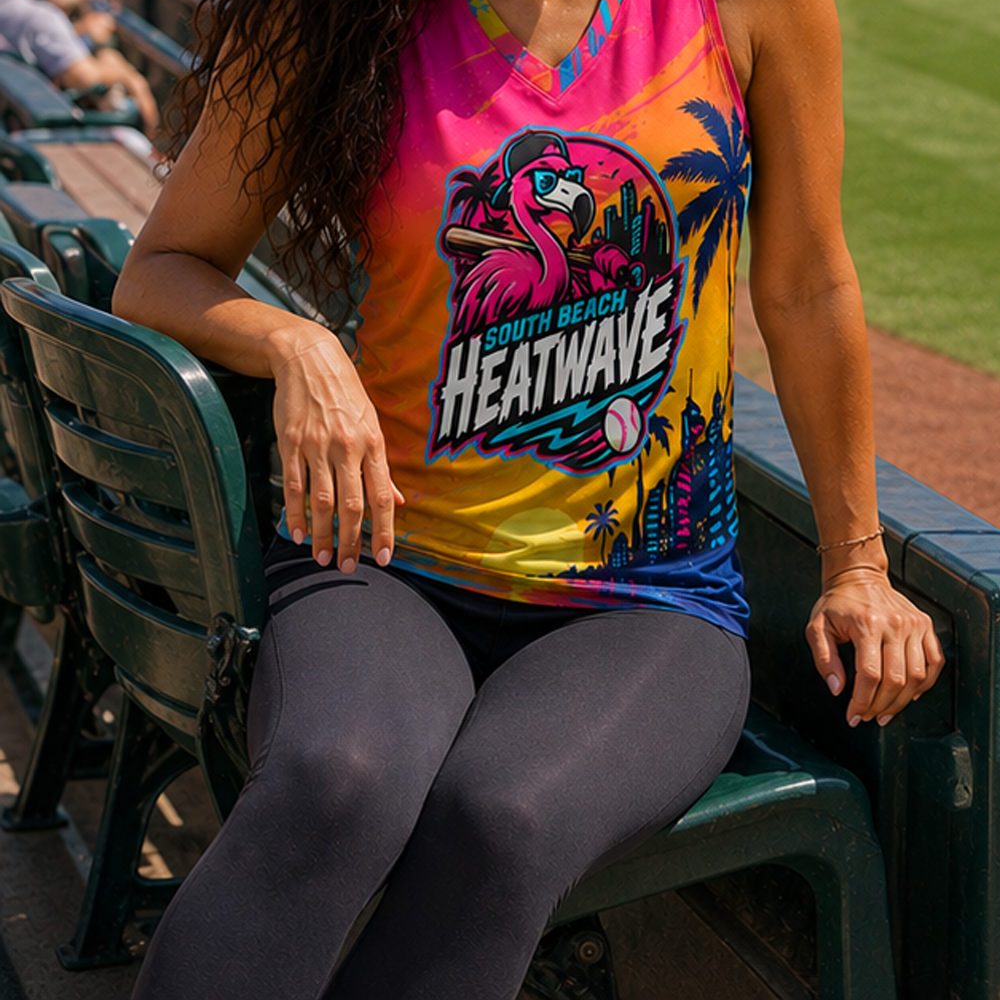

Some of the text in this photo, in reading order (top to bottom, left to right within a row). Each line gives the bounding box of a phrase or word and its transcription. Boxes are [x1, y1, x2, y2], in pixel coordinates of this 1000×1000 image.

[437, 279, 674, 440] HEATWAVE
[484, 288, 628, 351] SOUTH BEACH
